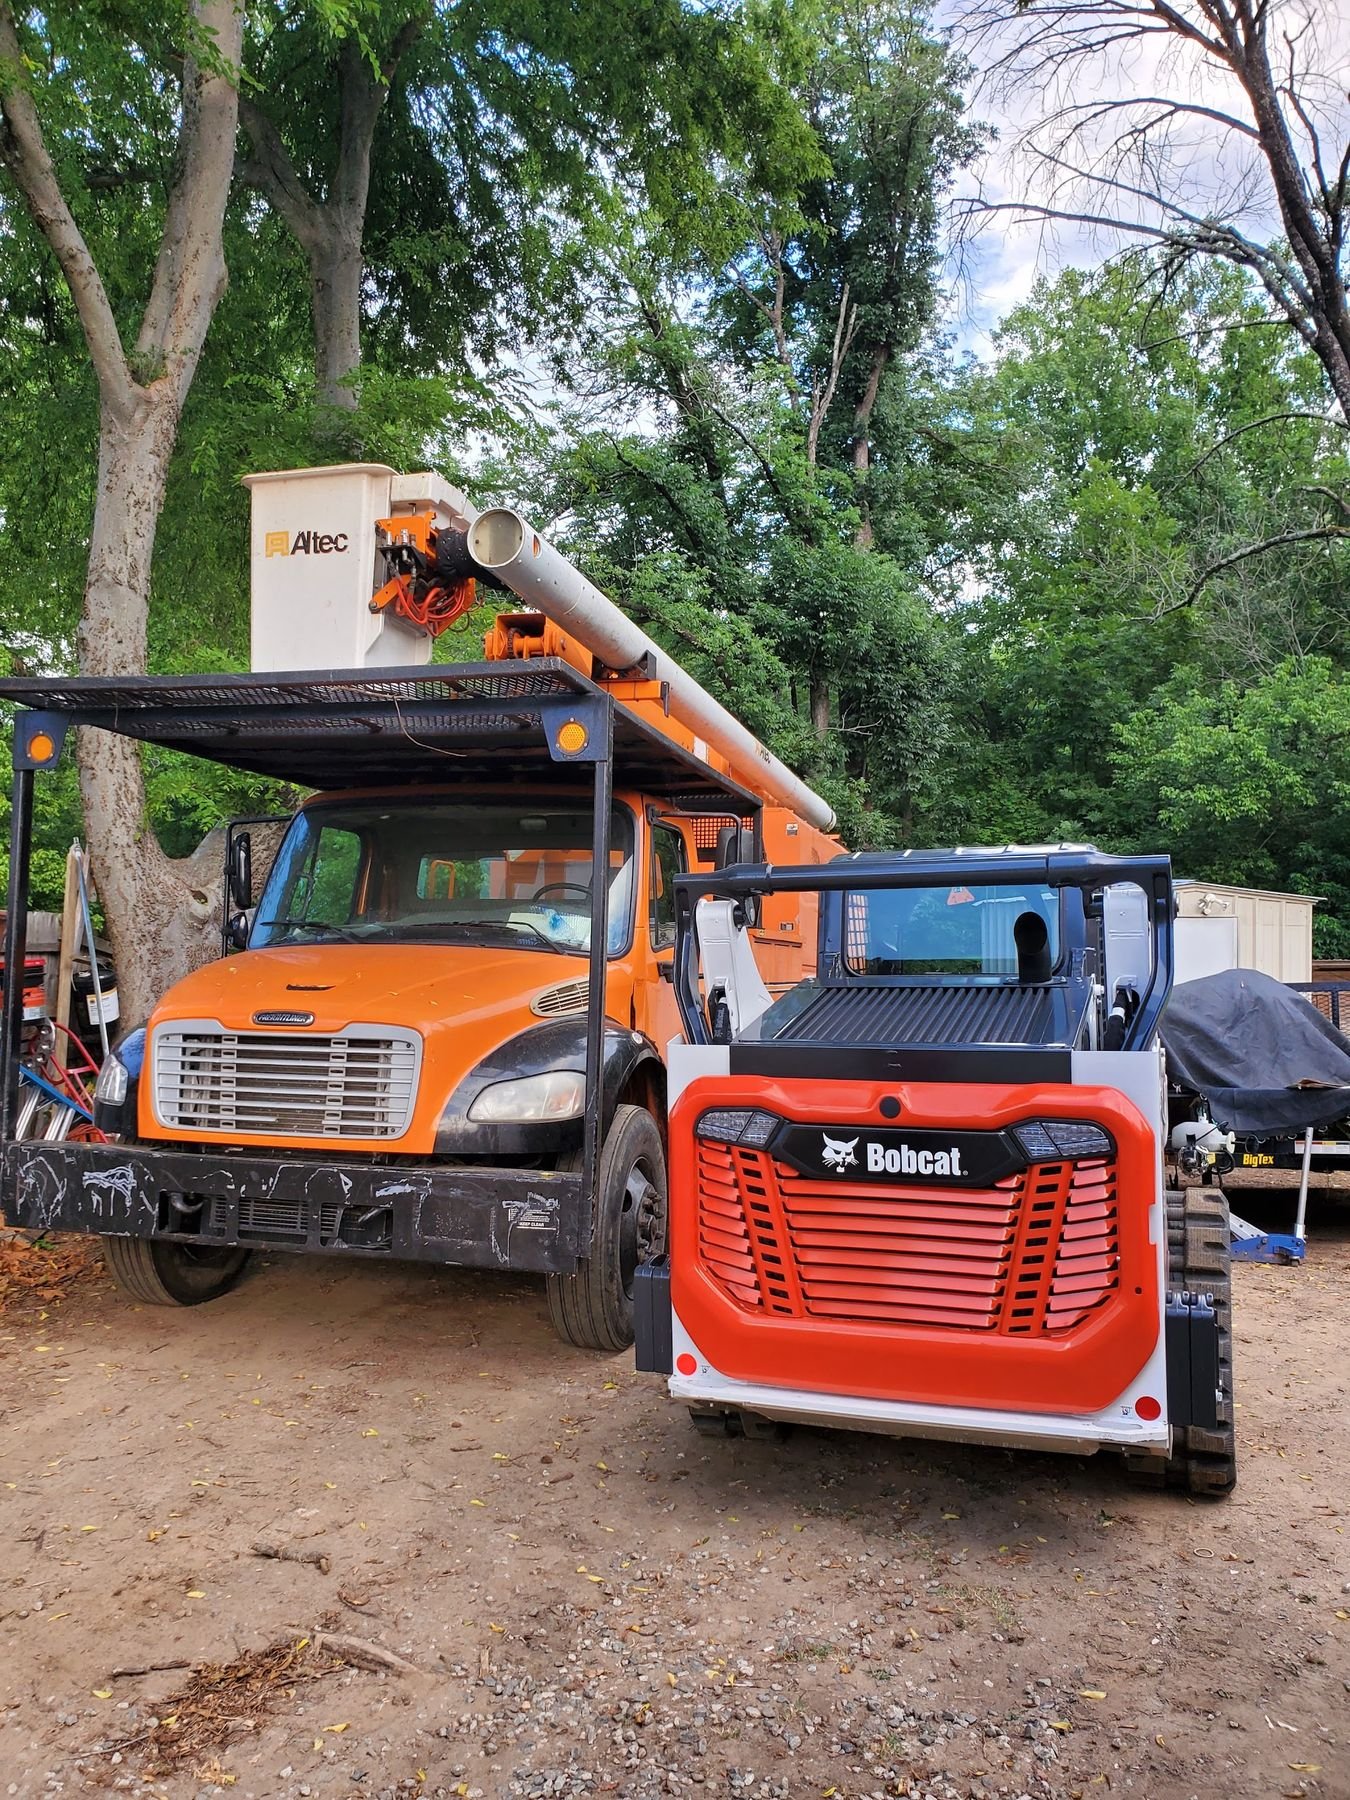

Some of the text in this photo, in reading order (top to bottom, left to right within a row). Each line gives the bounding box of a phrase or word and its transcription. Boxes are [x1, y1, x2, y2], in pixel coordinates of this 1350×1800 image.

[290, 530, 348, 555] Altec
[867, 1143, 961, 1176] Bobcat
[1243, 1154, 1274, 1167] BigTex
